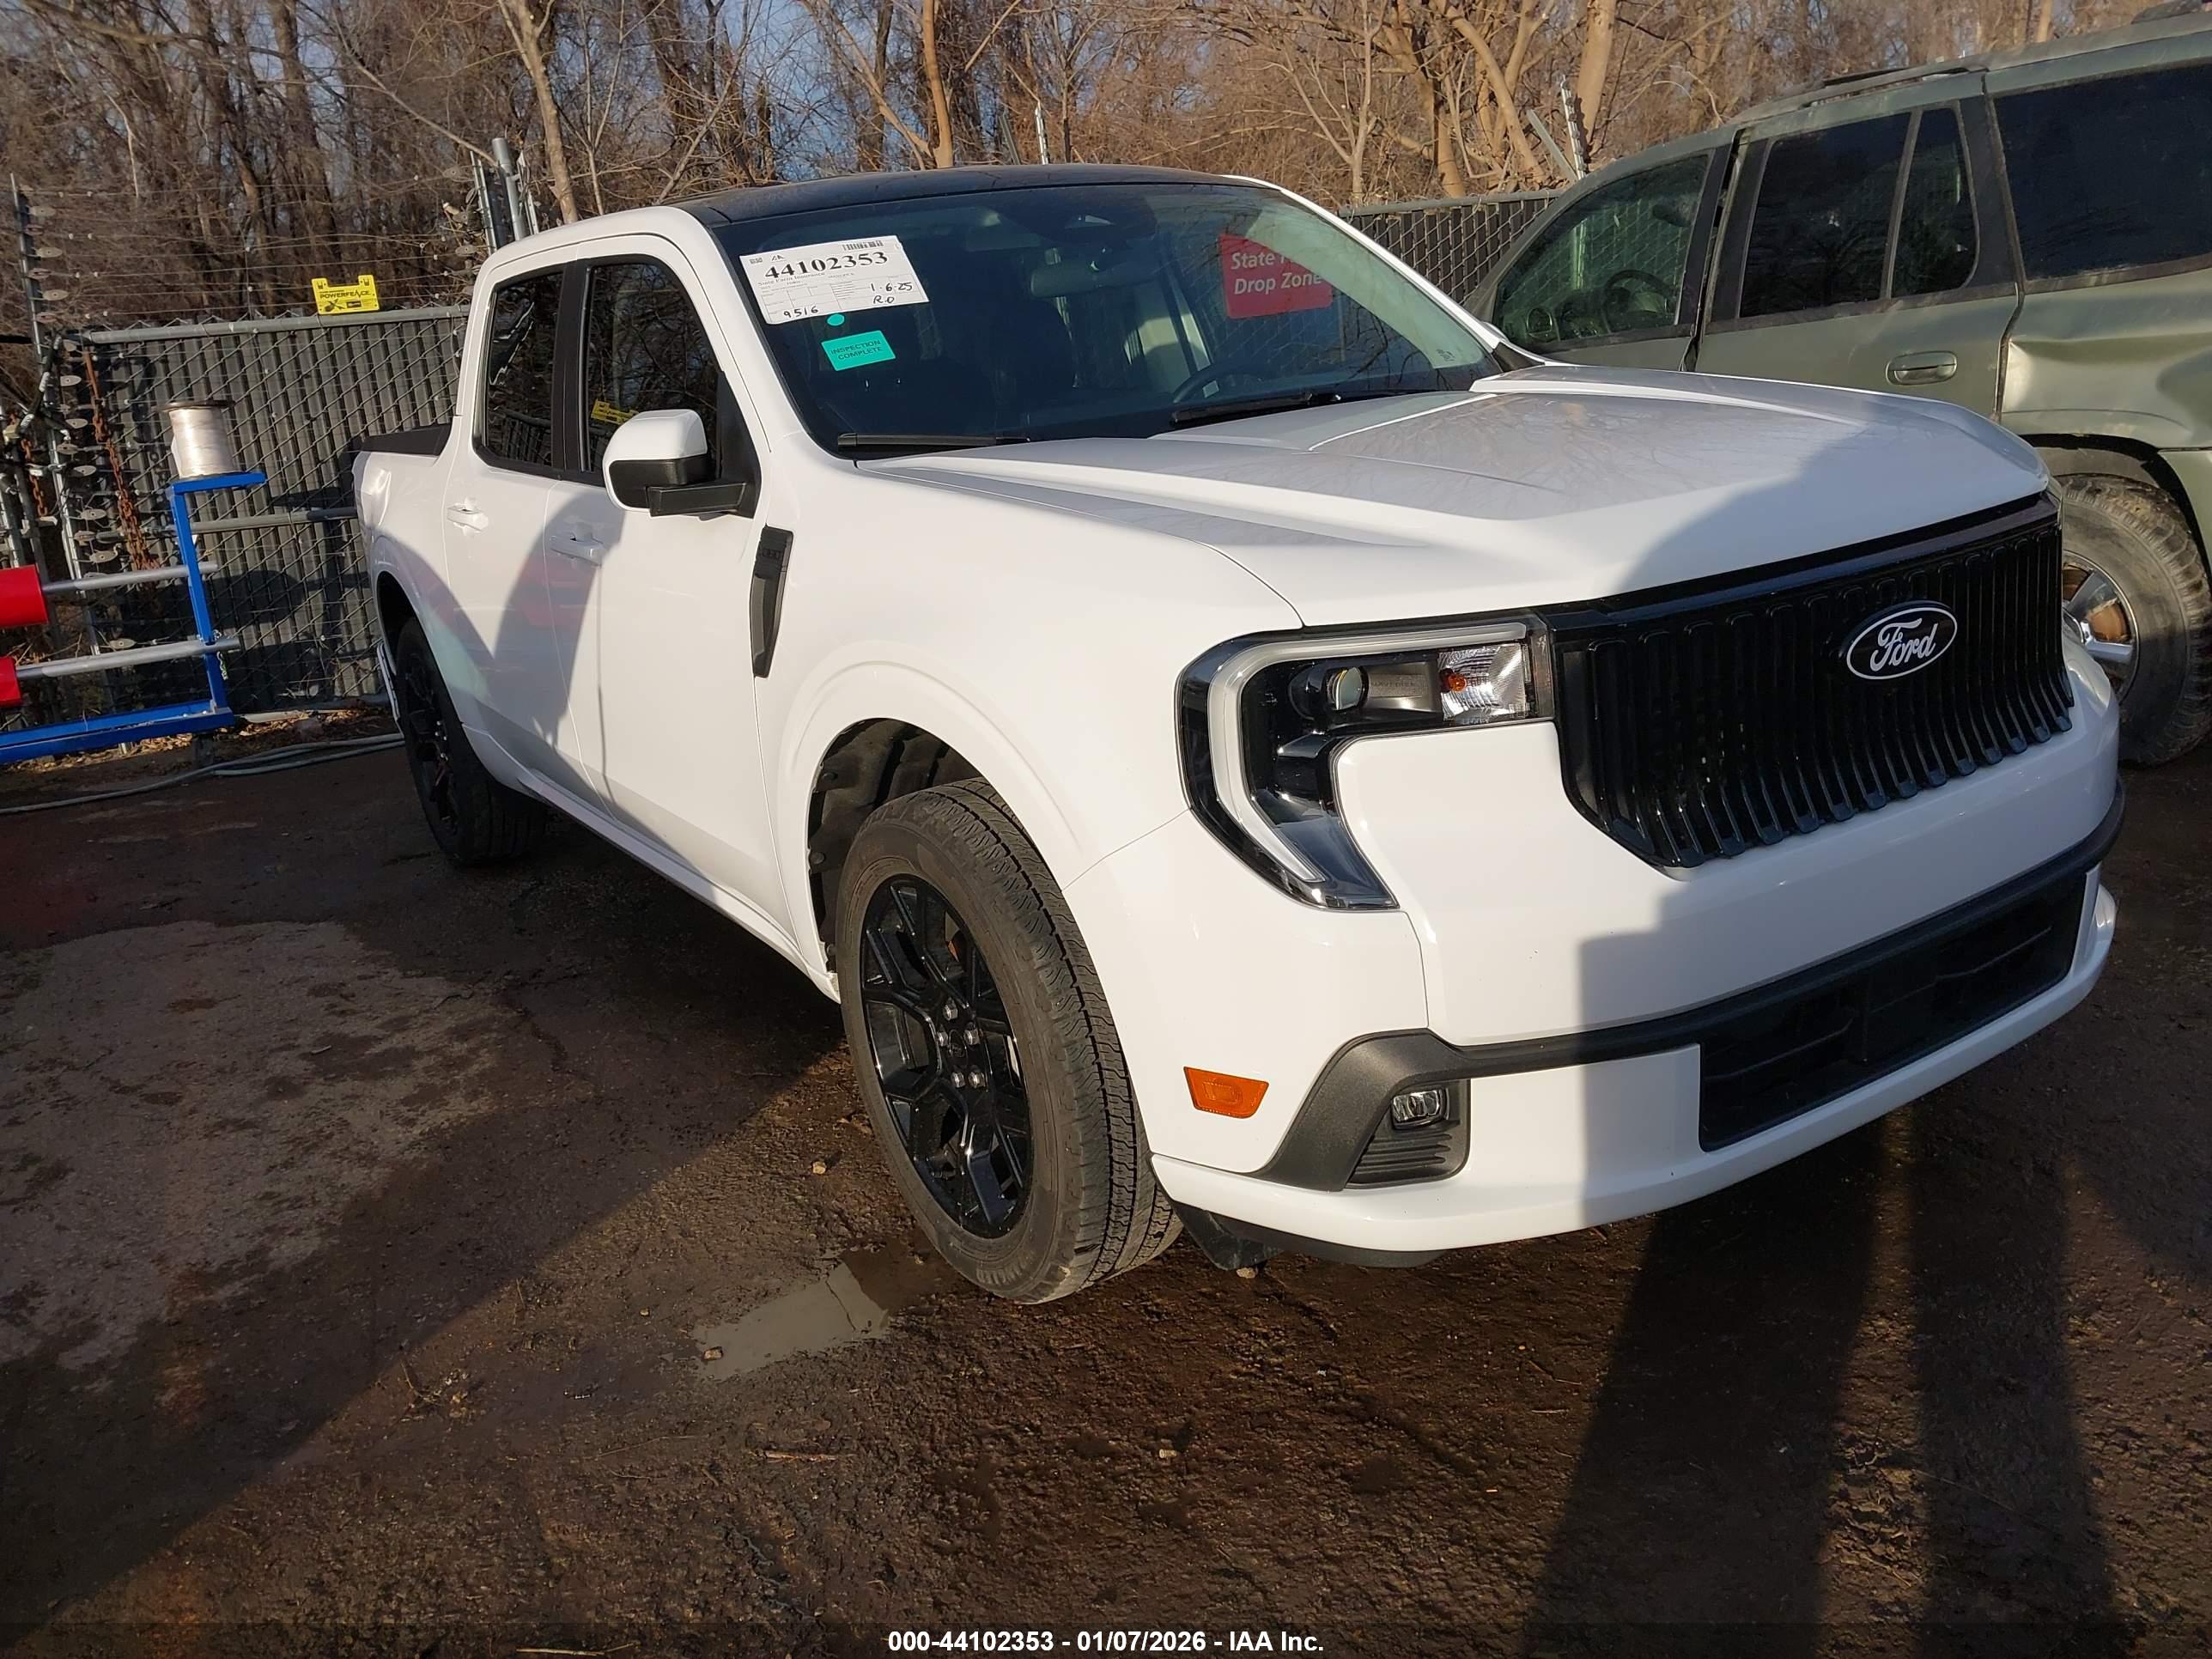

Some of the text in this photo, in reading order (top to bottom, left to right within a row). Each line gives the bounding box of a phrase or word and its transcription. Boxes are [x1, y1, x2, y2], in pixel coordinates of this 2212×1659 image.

[764, 251, 889, 279] 44102353
[1231, 251, 1275, 270] State
[1234, 277, 1276, 295] Drop
[783, 306, 819, 319] 9516
[830, 340, 882, 355] INSPECTION
[838, 346, 883, 360] COMPLETE
[1869, 617, 1939, 672] Ford
